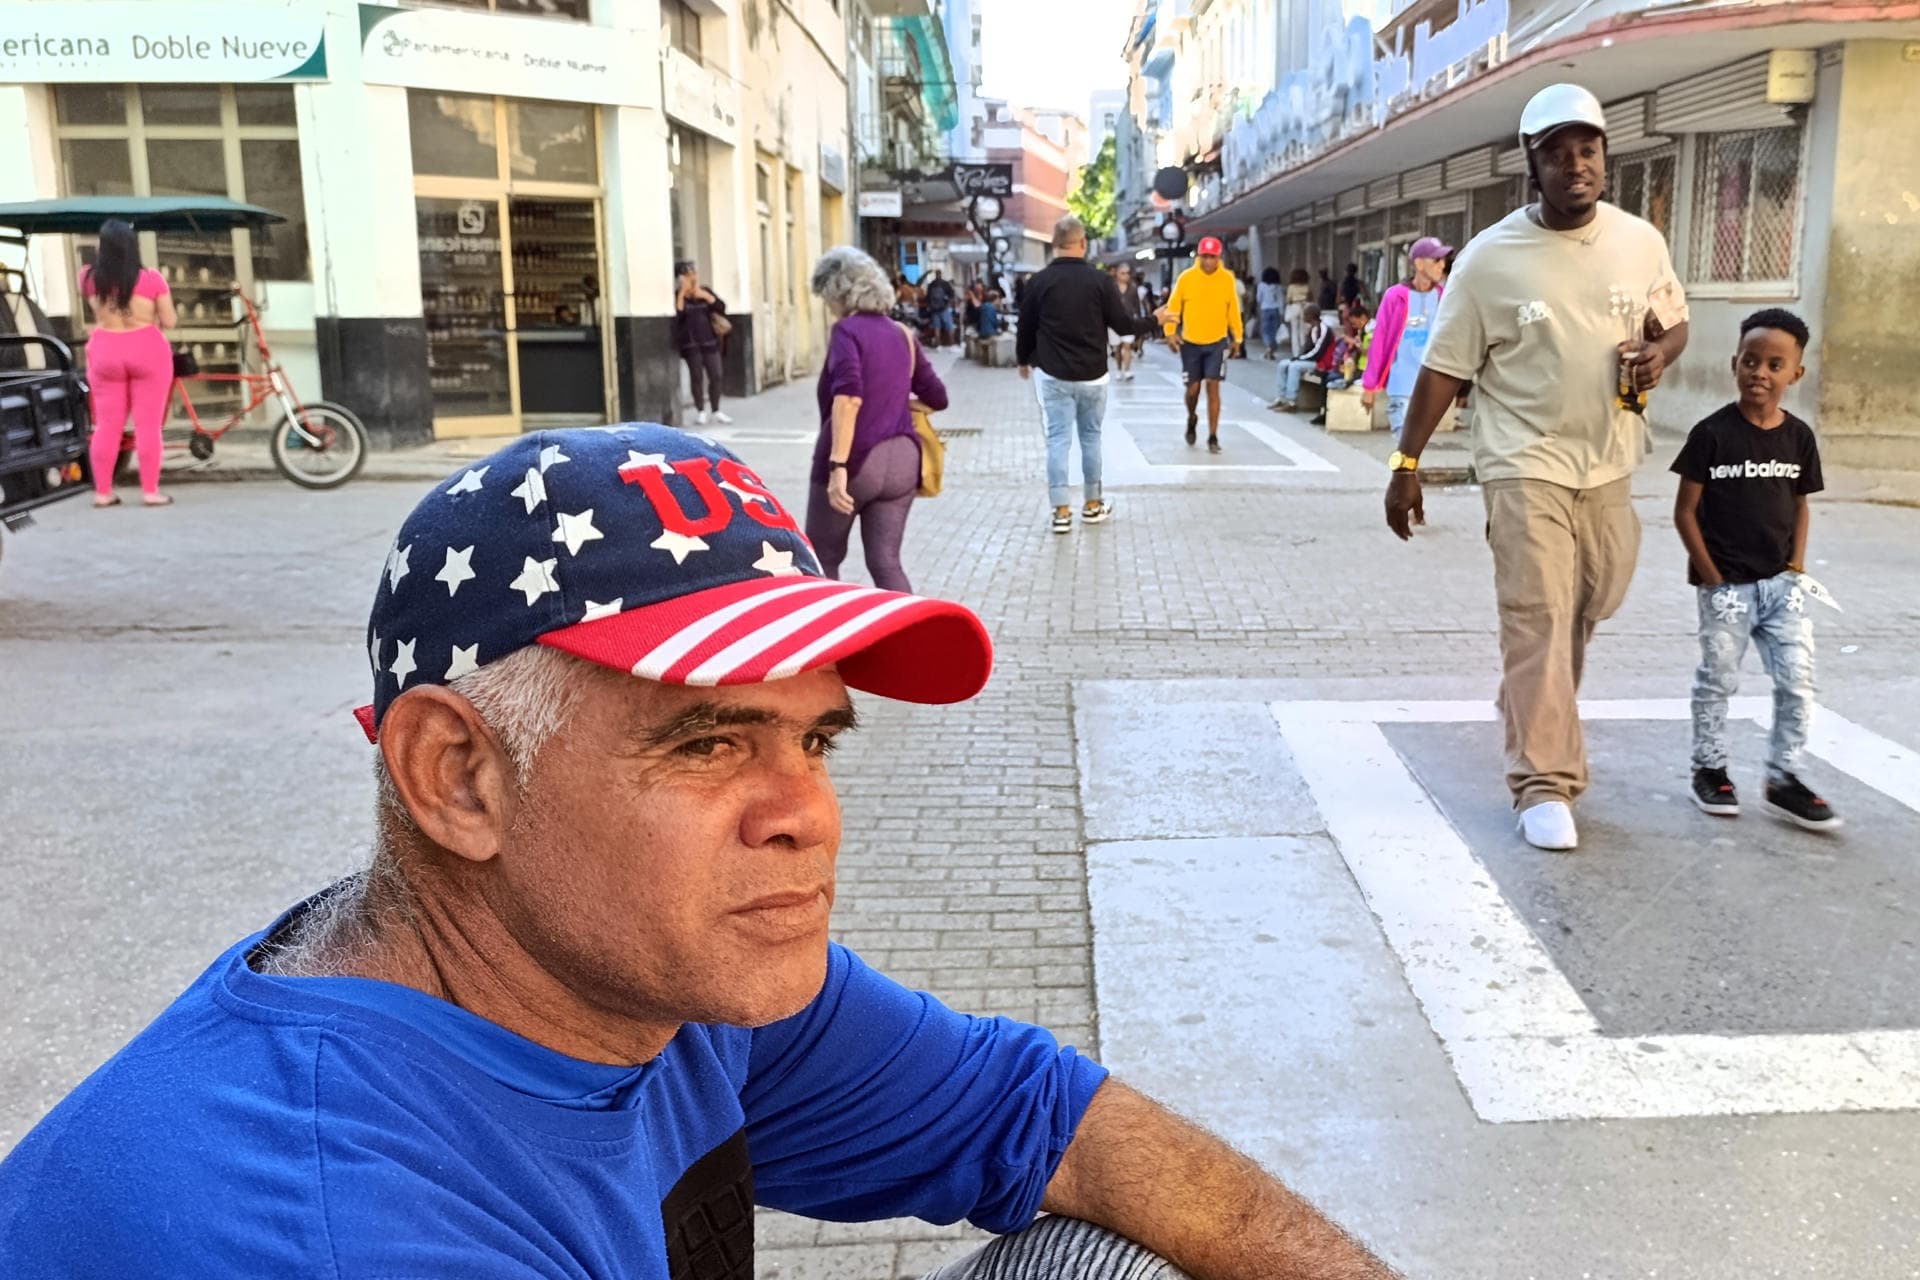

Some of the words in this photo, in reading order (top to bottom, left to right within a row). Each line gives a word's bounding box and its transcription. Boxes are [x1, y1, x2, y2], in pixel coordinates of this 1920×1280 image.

[2, 32, 110, 56] ericana
[132, 35, 211, 59] Doble
[222, 35, 308, 59] Nueve
[1744, 459, 1801, 479] balanc
[617, 457, 813, 549] US
